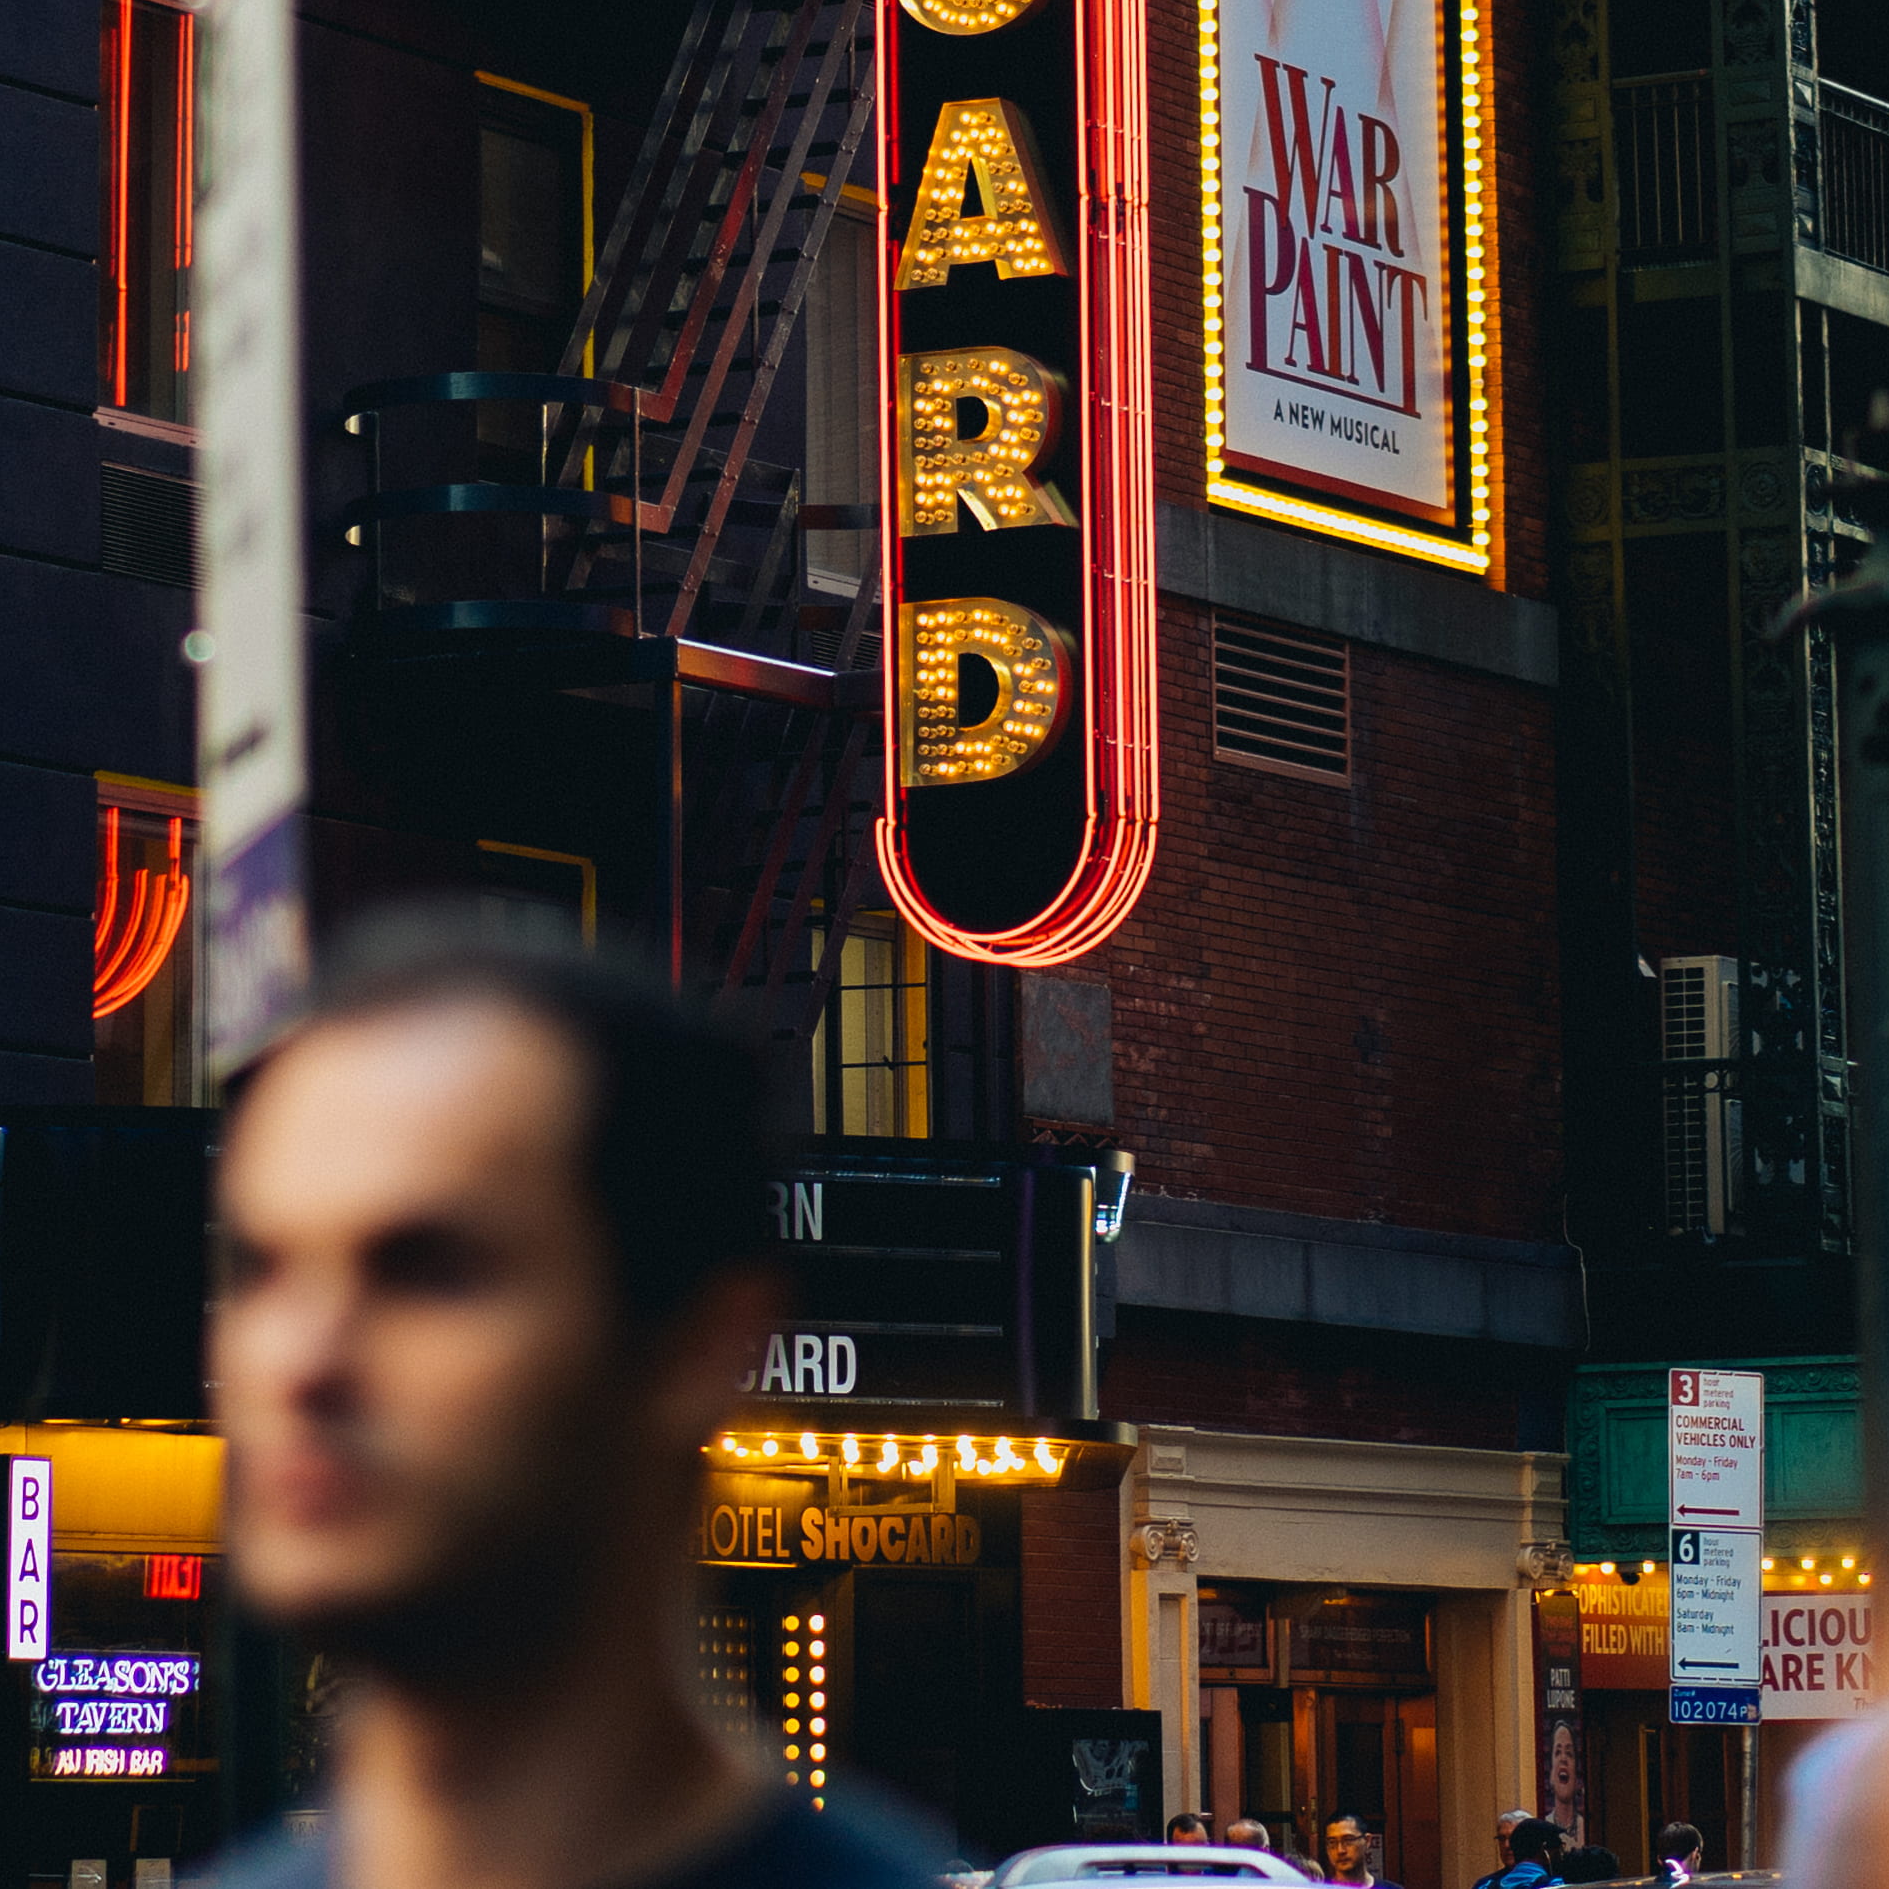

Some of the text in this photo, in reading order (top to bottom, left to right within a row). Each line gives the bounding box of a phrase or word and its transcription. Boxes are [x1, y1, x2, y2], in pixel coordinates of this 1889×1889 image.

[1254, 53, 1404, 258] WAR
[1243, 186, 1427, 419] PAINT
[1274, 399, 1400, 455] A NEW MUSICAL
[738, 1334, 857, 1393] ARD
[1678, 1374, 1694, 1404] 3
[1704, 1389, 1734, 1399] metered
[1703, 1399, 1730, 1410] parking
[1675, 1415, 1745, 1431] COMMERCIAL
[1676, 1432, 1756, 1449] VEHICLES ONLY
[1675, 1455, 1738, 1470] Monday Friday
[1676, 1468, 1720, 1482] 7am 6pm
[801, 1507, 982, 1564] SHOCARD
[1679, 1533, 1694, 1562] 6
[19, 1476, 40, 1643] BAR
[1703, 1547, 1733, 1557] metered
[1703, 1558, 1730, 1568] parking
[1676, 1574, 1741, 1589] Monday Friday
[1676, 1590, 1734, 1602] 6pm Midnight
[1575, 1583, 1669, 1617] OPHISTICATE
[1676, 1609, 1714, 1622] Saturday
[1676, 1623, 1734, 1636] 8am Midnight
[1762, 1607, 1872, 1647] ICIOU
[1582, 1623, 1627, 1654] FILLED
[1629, 1625, 1665, 1656] WITH
[36, 1658, 190, 1695] GLEASON'S
[1759, 1654, 1825, 1692] ARE
[56, 1702, 167, 1734] TAVERN
[84, 1748, 125, 1775] IRISH
[128, 1749, 164, 1776] BAR
